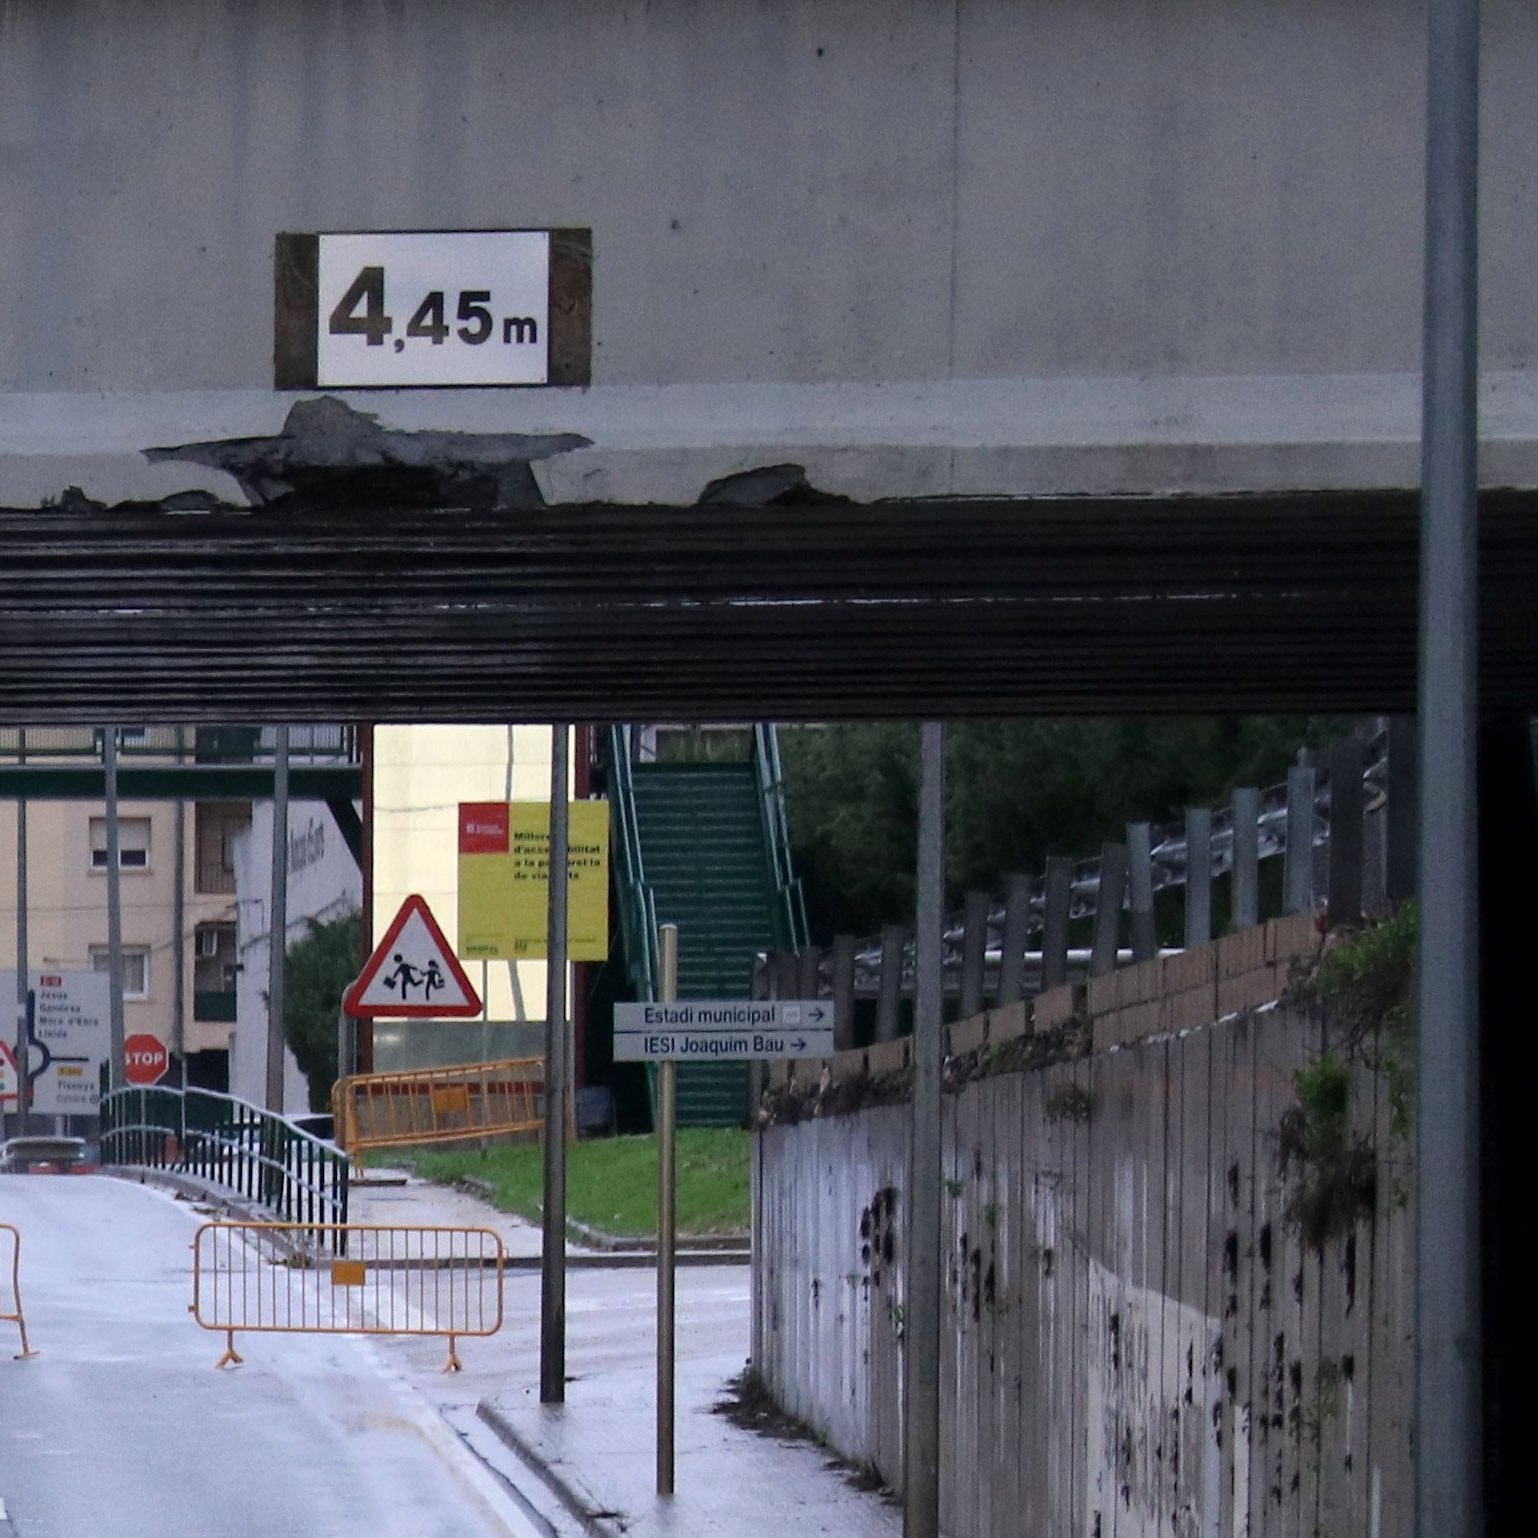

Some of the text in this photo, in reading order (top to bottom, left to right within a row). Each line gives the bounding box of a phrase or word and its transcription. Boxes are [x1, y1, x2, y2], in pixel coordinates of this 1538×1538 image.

[644, 1006, 776, 1026] Estadi municipal
[679, 1036, 748, 1056] Joaquim
[752, 1036, 785, 1052] Bau
